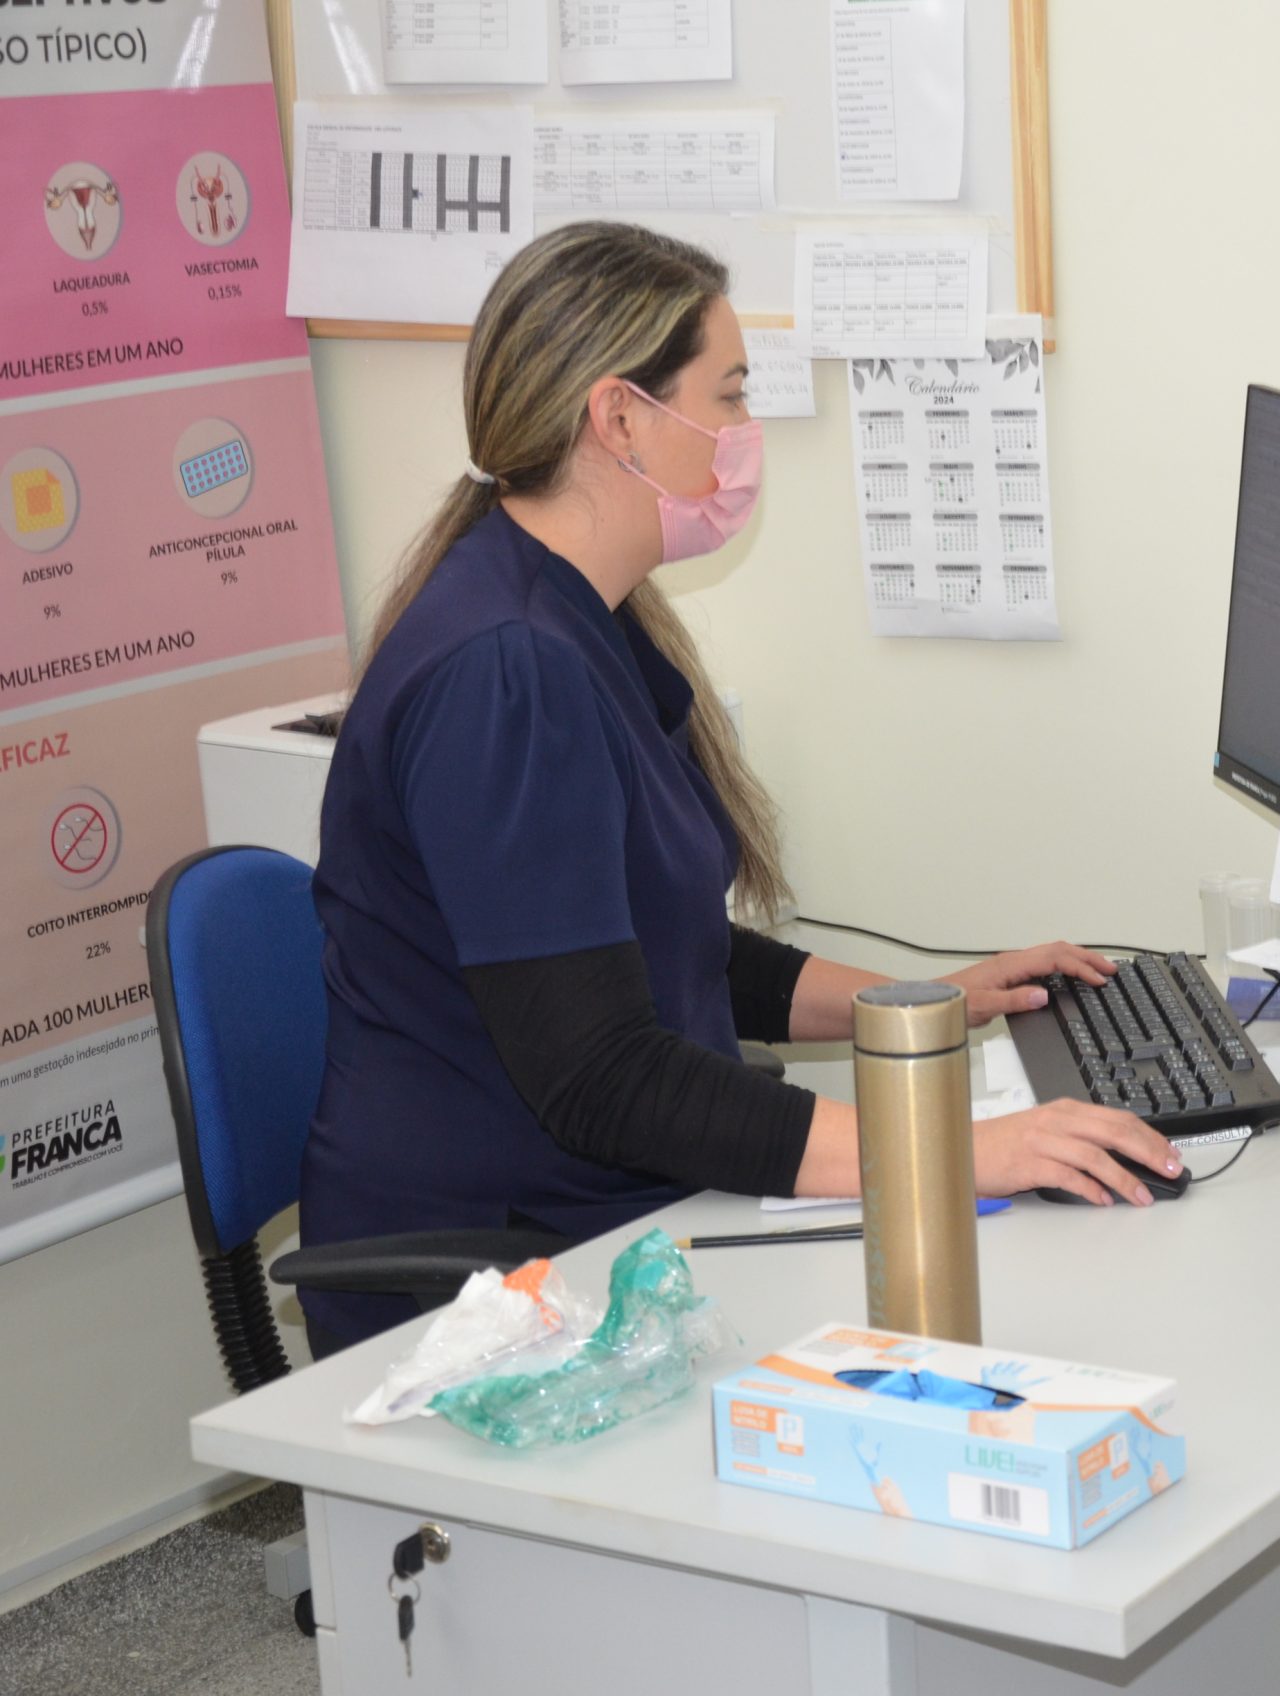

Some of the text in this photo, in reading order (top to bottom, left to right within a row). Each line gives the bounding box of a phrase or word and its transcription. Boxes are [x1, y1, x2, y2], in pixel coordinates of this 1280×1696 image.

[36, 26, 147, 64] TÍPICO)
[185, 257, 259, 277] VASECTOMIA
[53, 272, 130, 293] LAQUEADURA
[207, 284, 242, 301] 0,15%
[82, 301, 108, 317] 0,5%
[87, 349, 112, 369] EM
[113, 343, 143, 363] UM
[146, 337, 184, 359] ANO
[934, 396, 955, 405] 2024
[149, 519, 298, 559] ANTICONCEPCIONAL ORAL
[206, 545, 246, 564] PÍLULA
[22, 563, 73, 585] ADESIVO
[220, 570, 238, 586] 9%
[0, 630, 195, 691] MULHERES EM UM ANO
[0, 733, 71, 773] FICAZ
[27, 917, 65, 939] COITO
[86, 941, 111, 960] 22%
[43, 1007, 74, 1033] 100
[76, 981, 154, 1021] MULHER
[11, 1068, 32, 1085] uma
[33, 1054, 74, 1079] gestação
[76, 1034, 126, 1062] indesejada
[127, 1032, 139, 1045] no
[12, 1099, 115, 1148] PREFEITURA
[11, 1115, 122, 1180] FRANCA
